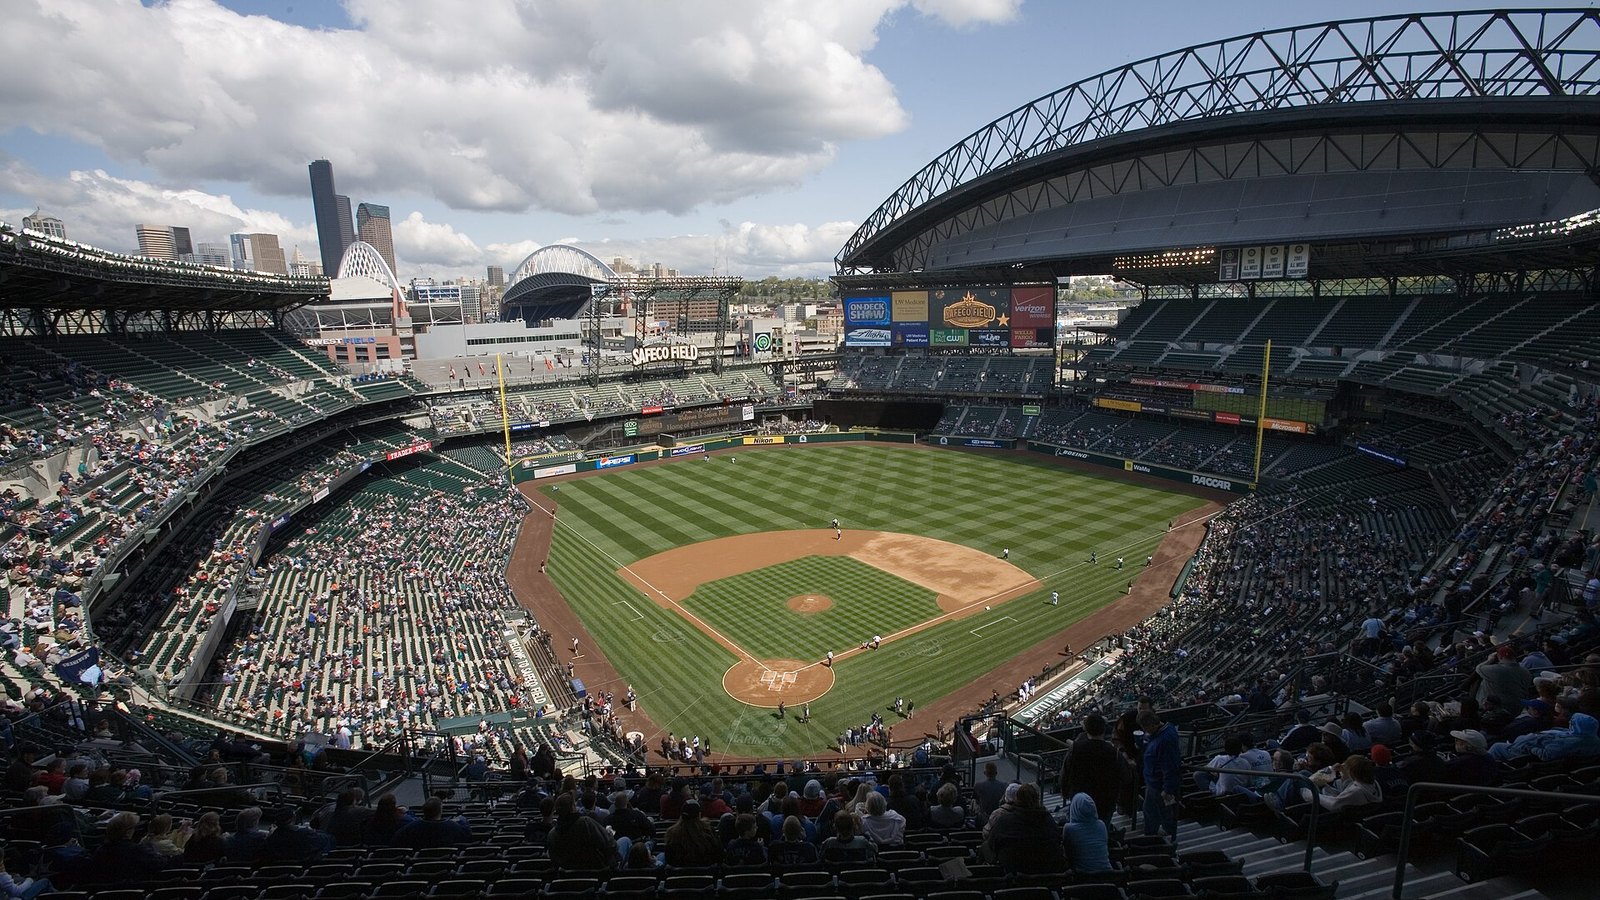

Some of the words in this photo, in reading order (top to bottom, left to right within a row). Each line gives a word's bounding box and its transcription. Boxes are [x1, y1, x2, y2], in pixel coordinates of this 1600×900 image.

[850, 310, 884, 320] SHOW
[945, 308, 972, 320] SAFECO
[972, 308, 993, 319] FIELD
[342, 336, 376, 344] FIELD
[632, 346, 670, 366] SAFECO
[670, 344, 698, 360] FIELD
[1270, 423, 1300, 432] Microsoft
[390, 448, 413, 460] TRADER
[1062, 450, 1088, 458] BOEING
[608, 456, 631, 466] PEPSI
[1134, 464, 1150, 472] WaMu
[1192, 475, 1231, 490] PACCAR
